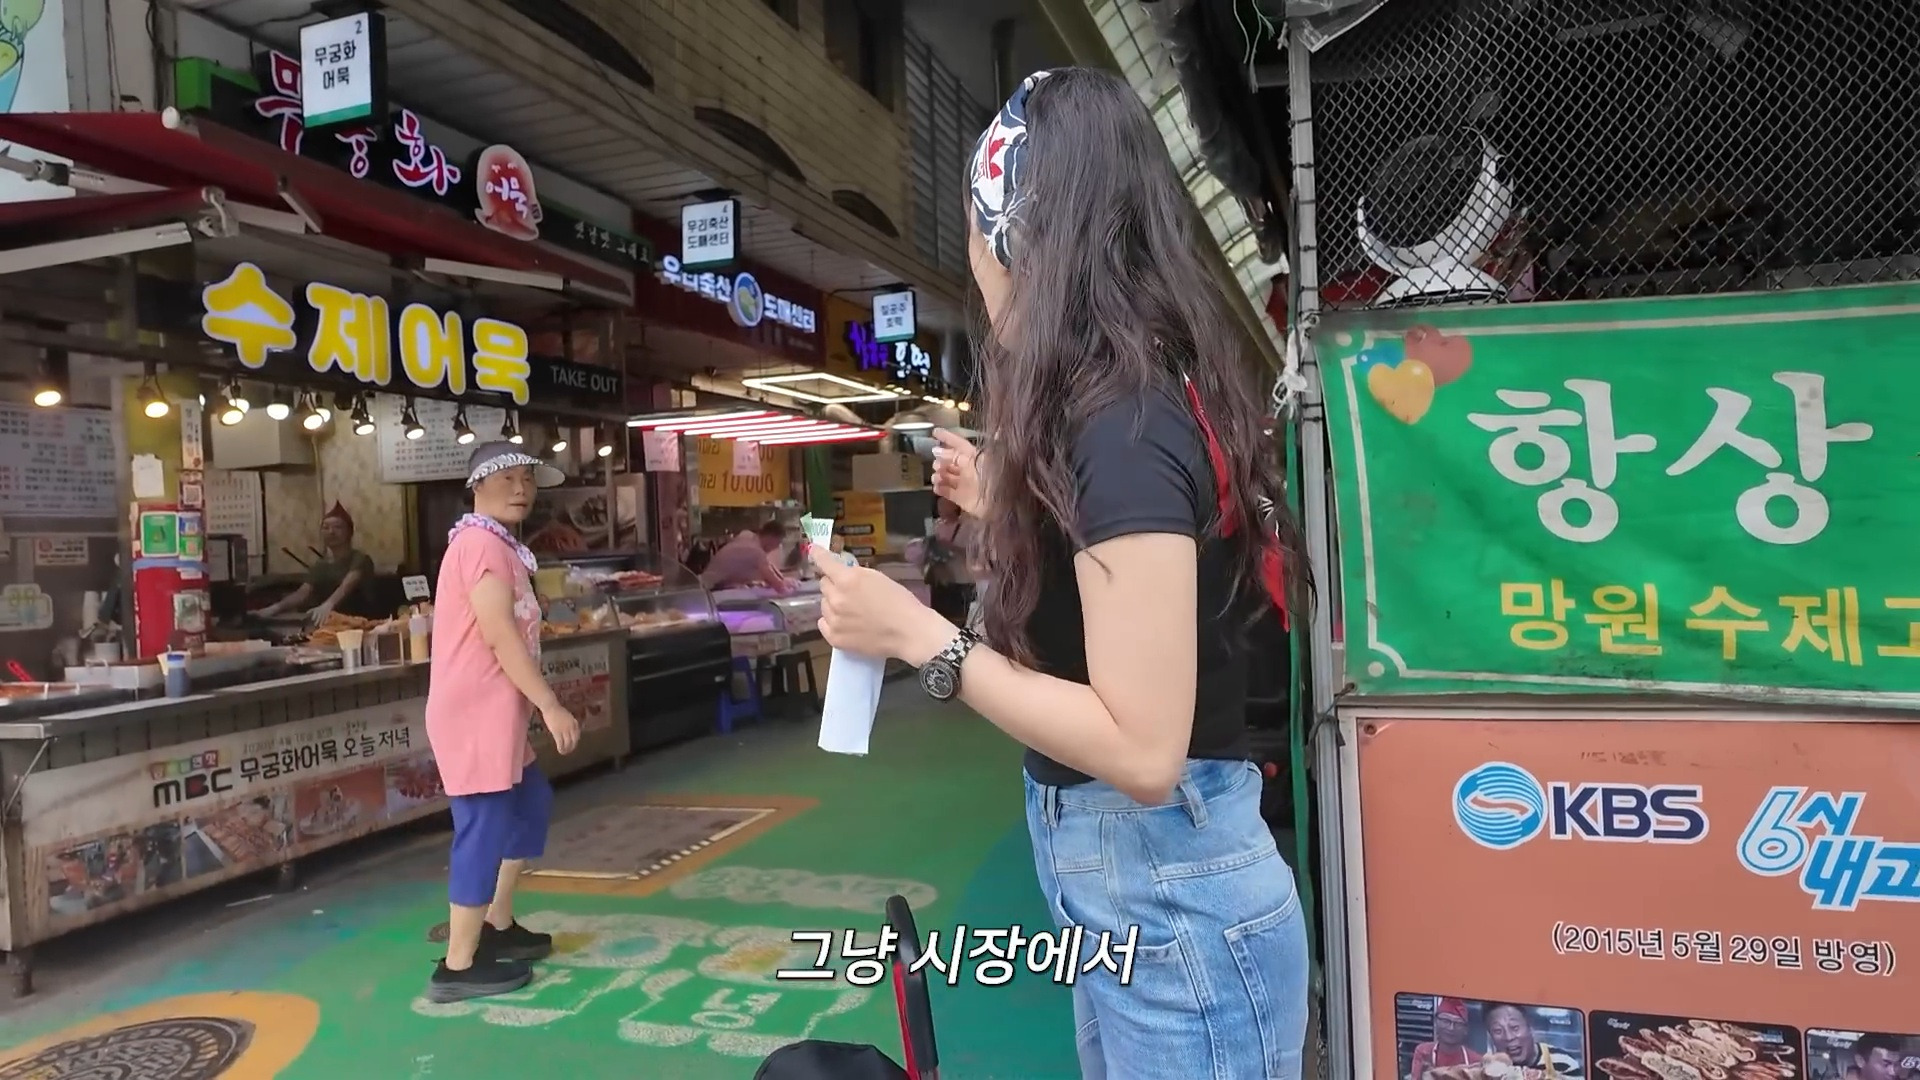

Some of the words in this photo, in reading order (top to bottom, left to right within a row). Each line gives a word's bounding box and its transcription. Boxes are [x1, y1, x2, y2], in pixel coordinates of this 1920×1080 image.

[354, 20, 362, 34] 2
[314, 40, 357, 66] 무궁화
[322, 66, 351, 90] 어묵
[486, 177, 528, 219] 어묵
[687, 216, 729, 233] 우리축산
[687, 233, 729, 249] 도매센터
[764, 292, 816, 333] 도매센터
[201, 261, 530, 406] 수제어묵
[549, 365, 587, 389] TAKE
[590, 373, 619, 395] OUT
[1467, 372, 1873, 544] 항상
[1500, 579, 1662, 656] 망원
[240, 740, 338, 783] 무궁화어묵
[1548, 781, 1709, 844] KBS
[1551, 921, 1665, 960] (2015년
[1672, 931, 1723, 964] 5월
[1729, 935, 1803, 970] 29일
[1813, 938, 1895, 977] 방영)
